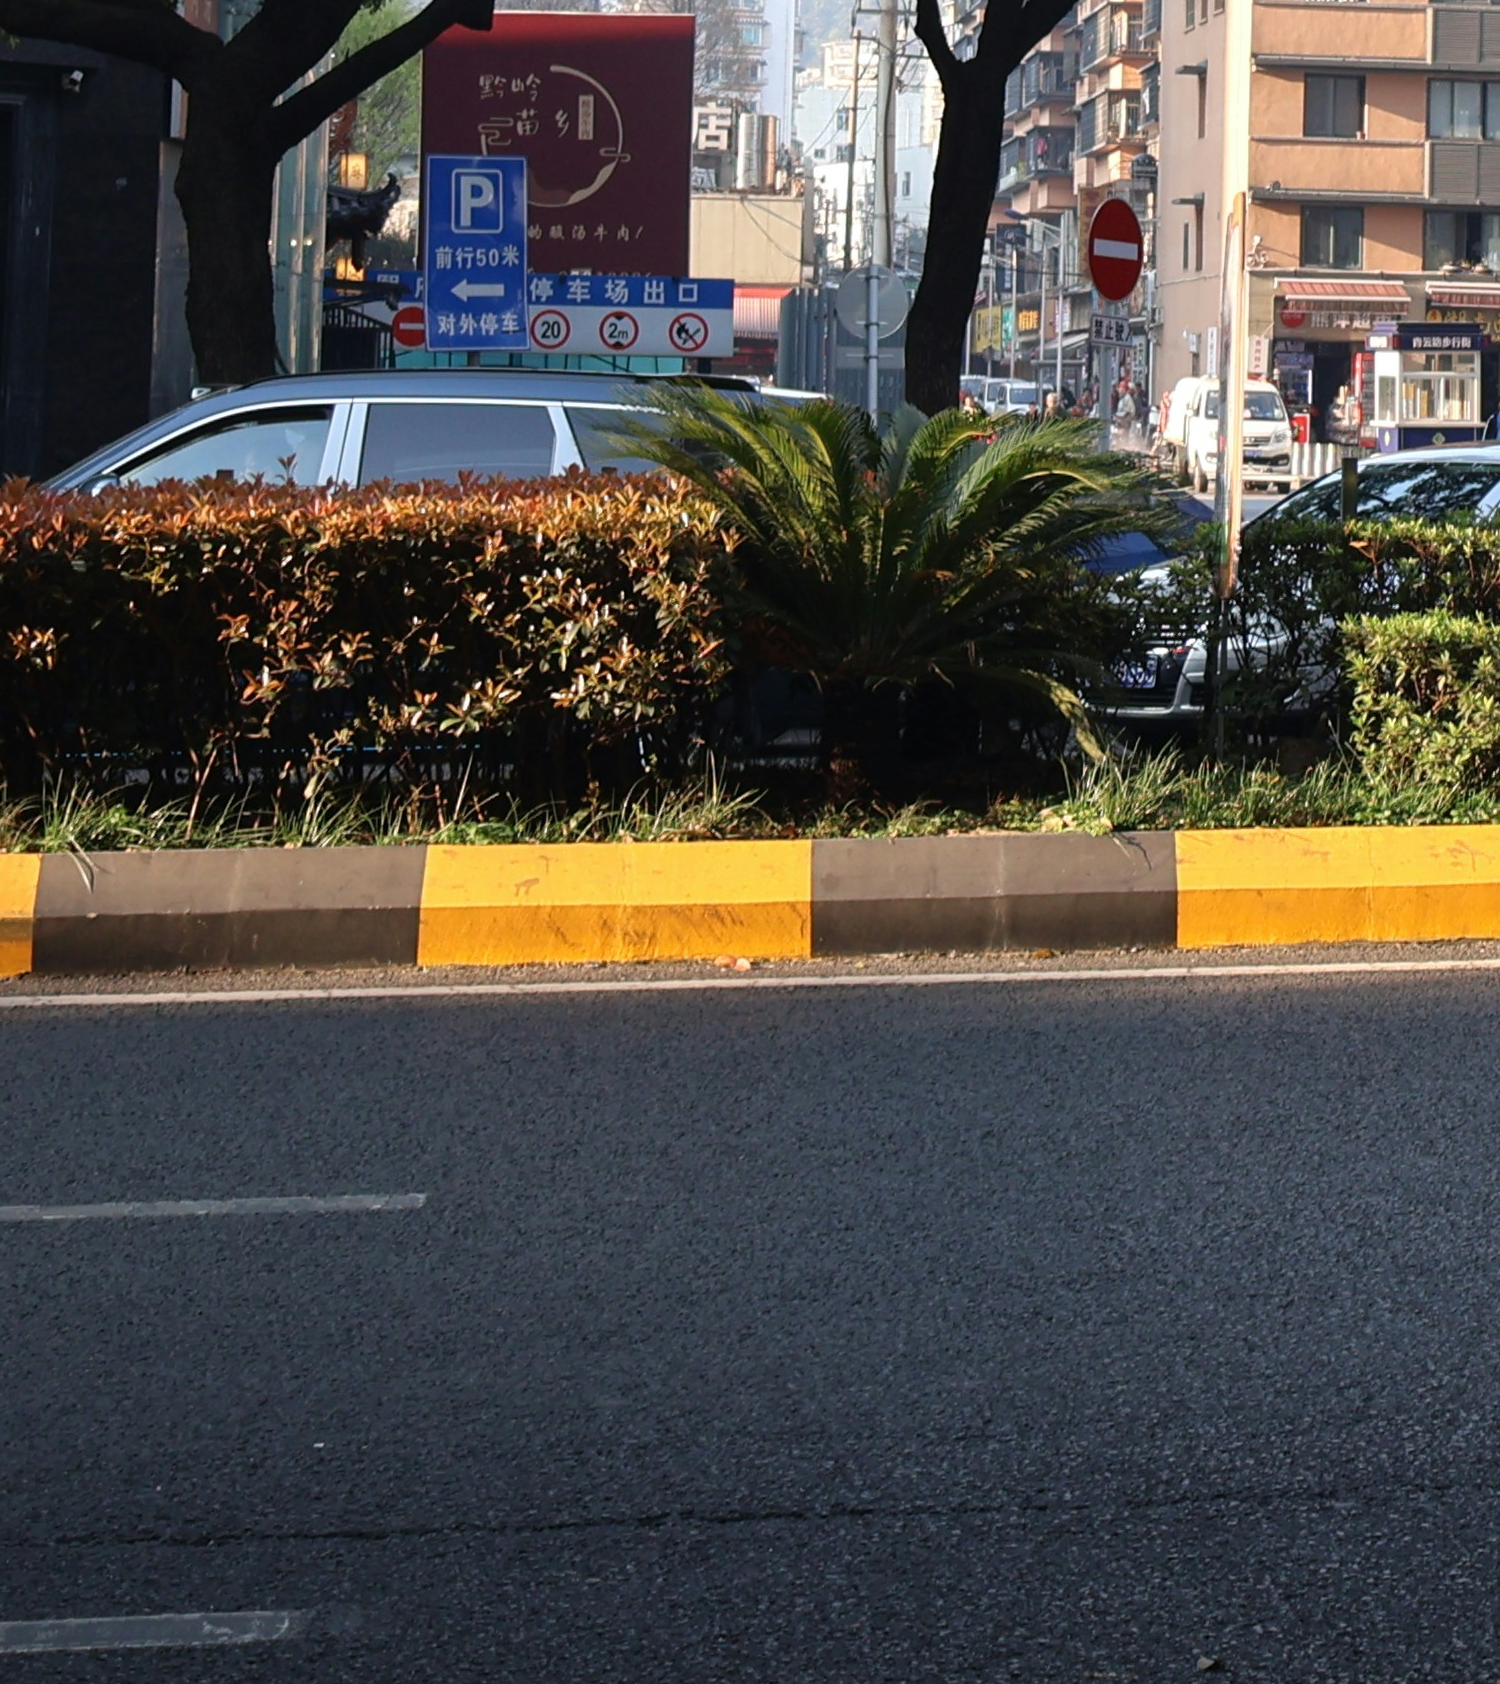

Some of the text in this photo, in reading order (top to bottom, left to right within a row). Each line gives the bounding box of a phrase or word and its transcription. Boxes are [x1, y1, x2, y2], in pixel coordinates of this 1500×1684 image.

[479, 73, 541, 103] 黔岭
[516, 108, 570, 138] 苗乡
[693, 101, 732, 150] 店
[459, 175, 494, 227] P
[435, 244, 520, 269] 前行50米
[529, 276, 698, 305] 停车场出口
[438, 313, 520, 337] 对外停车
[541, 321, 561, 339] 20
[608, 322, 629, 340] 2m
